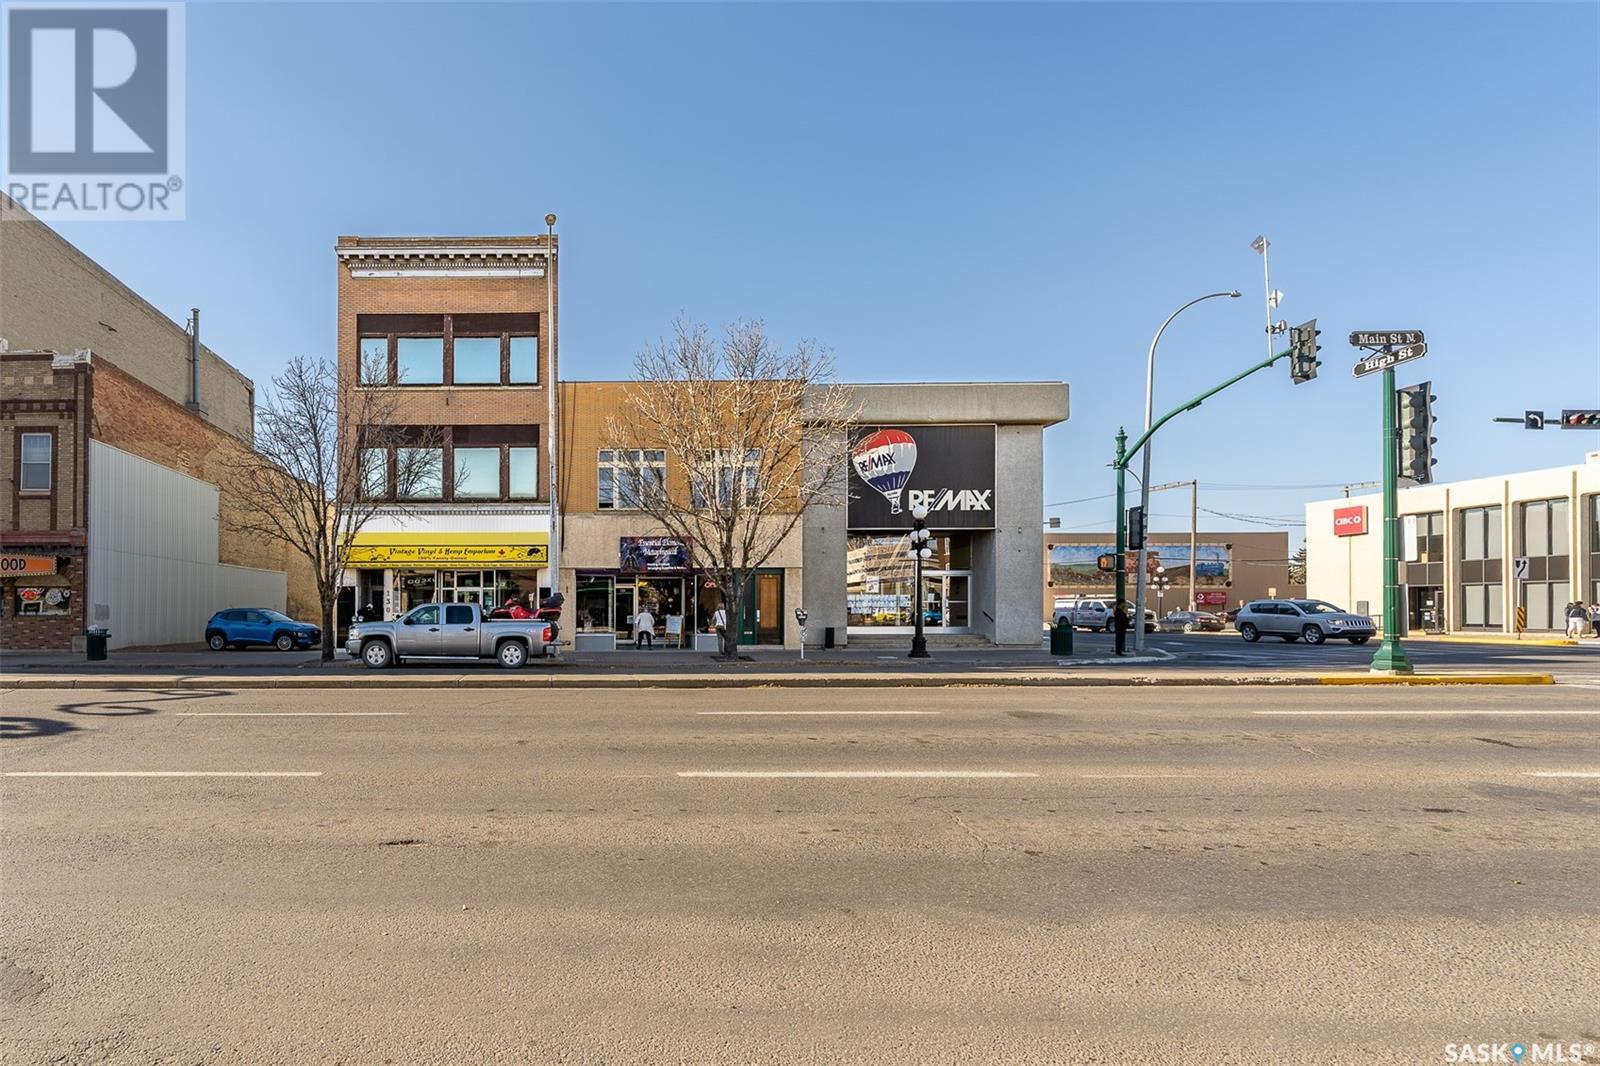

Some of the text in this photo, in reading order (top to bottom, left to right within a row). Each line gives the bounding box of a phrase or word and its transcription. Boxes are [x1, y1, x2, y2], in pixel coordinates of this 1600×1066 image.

[1358, 334, 1387, 344] Main
[1390, 333, 1402, 344] St
[1364, 347, 1413, 371] High St
[859, 452, 896, 472] RE/MAX
[908, 488, 992, 512] RE/MAX
[1335, 516, 1353, 526] CIBC
[389, 548, 415, 556] Vintage
[418, 548, 437, 556] Vinyl
[444, 548, 462, 556] Hemp
[464, 548, 496, 556] Emporium
[1, 558, 26, 571] OOD
